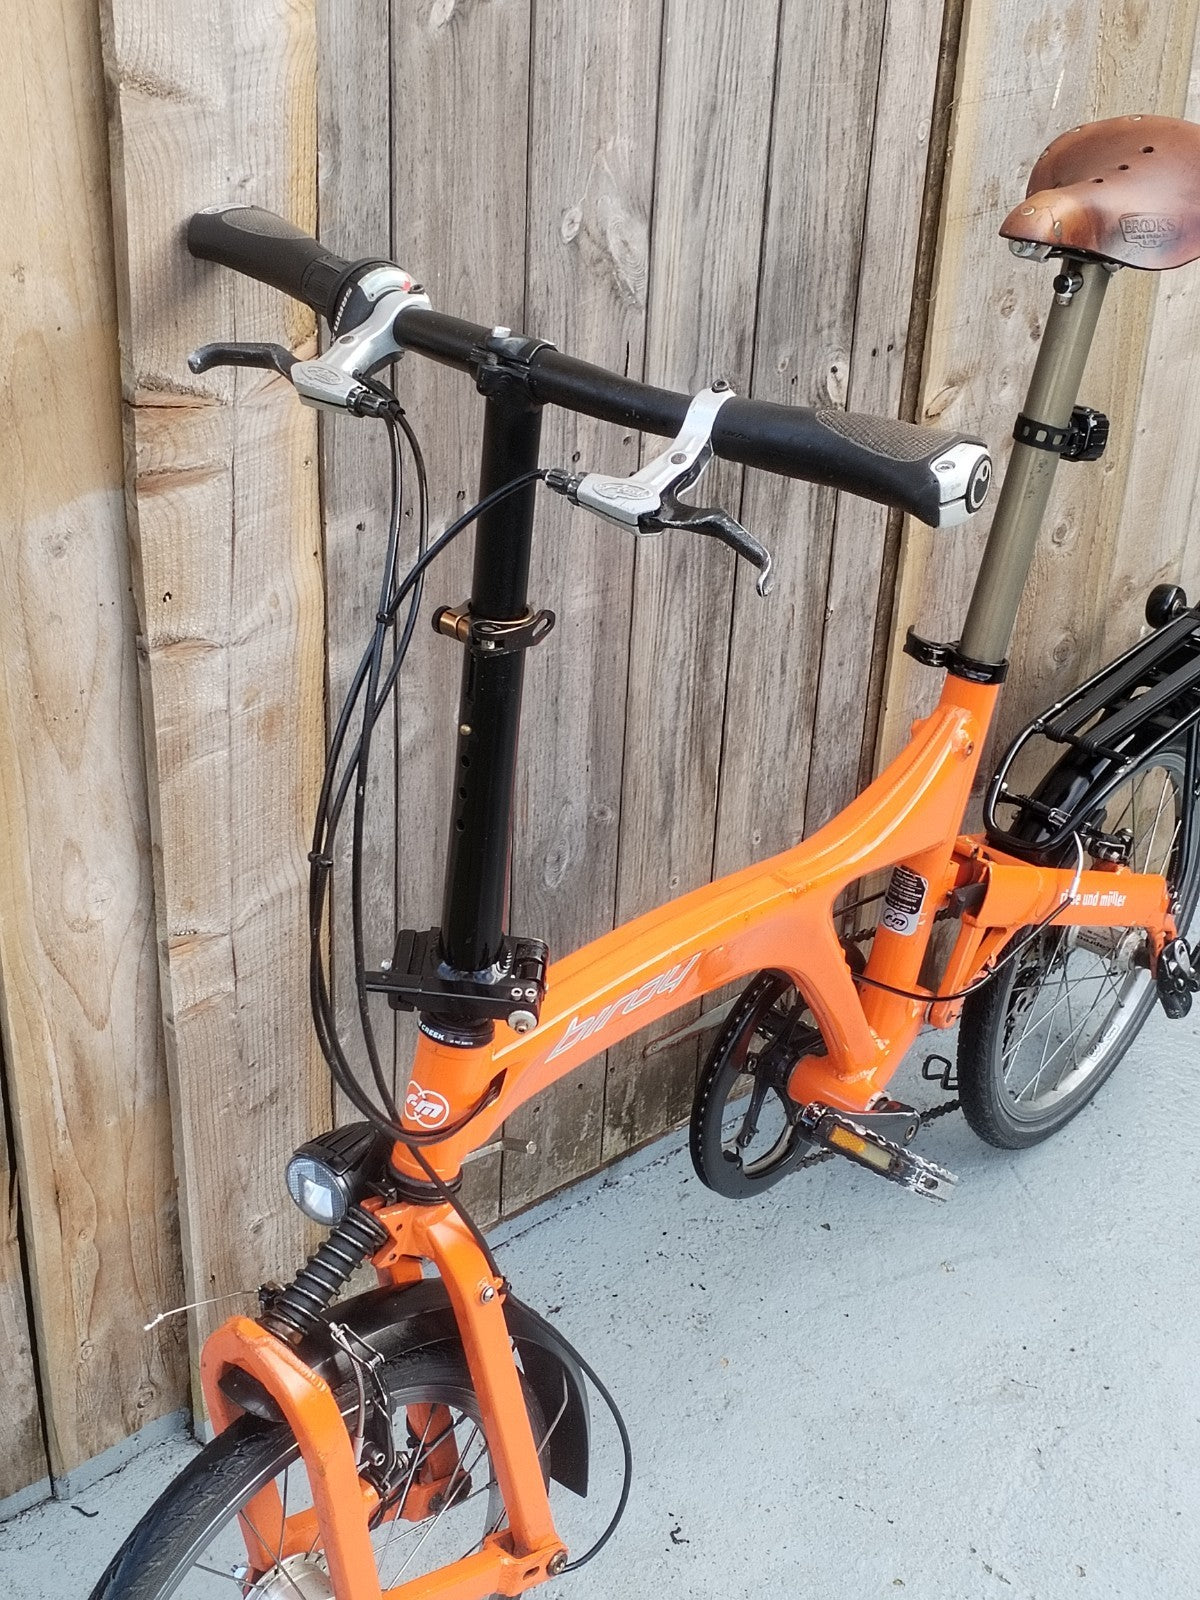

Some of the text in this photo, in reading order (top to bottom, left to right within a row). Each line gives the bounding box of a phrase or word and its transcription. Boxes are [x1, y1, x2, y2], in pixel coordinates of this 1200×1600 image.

[1123, 217, 1176, 234] BROOKS
[1060, 888, 1126, 907] rie und müller
[544, 951, 702, 1065] birdy
[421, 1024, 445, 1041] CREEK
